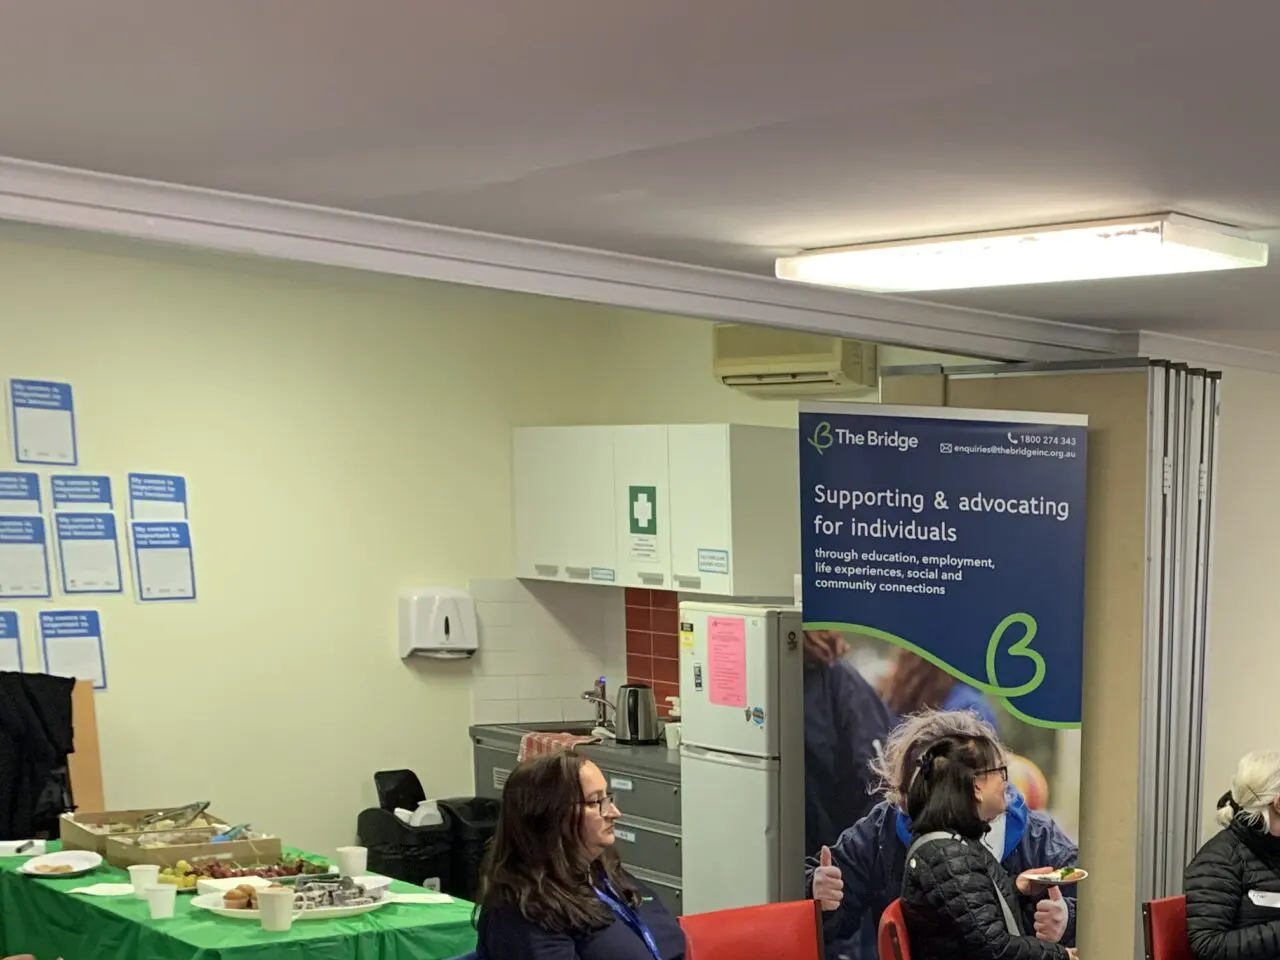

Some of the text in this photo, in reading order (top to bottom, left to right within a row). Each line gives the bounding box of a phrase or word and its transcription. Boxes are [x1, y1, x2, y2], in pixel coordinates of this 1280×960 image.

[835, 428, 919, 451] The Bridge
[1020, 434, 1077, 446] 1800 274 343
[954, 443, 1076, 459] enquiries@thebridgeinc.org.au
[814, 484, 1070, 521] Supporting & advocating
[813, 515, 957, 542] for individuals
[814, 547, 995, 569] through education, employment,
[815, 561, 963, 581] life experiences, social and
[815, 578, 946, 595] community connections
